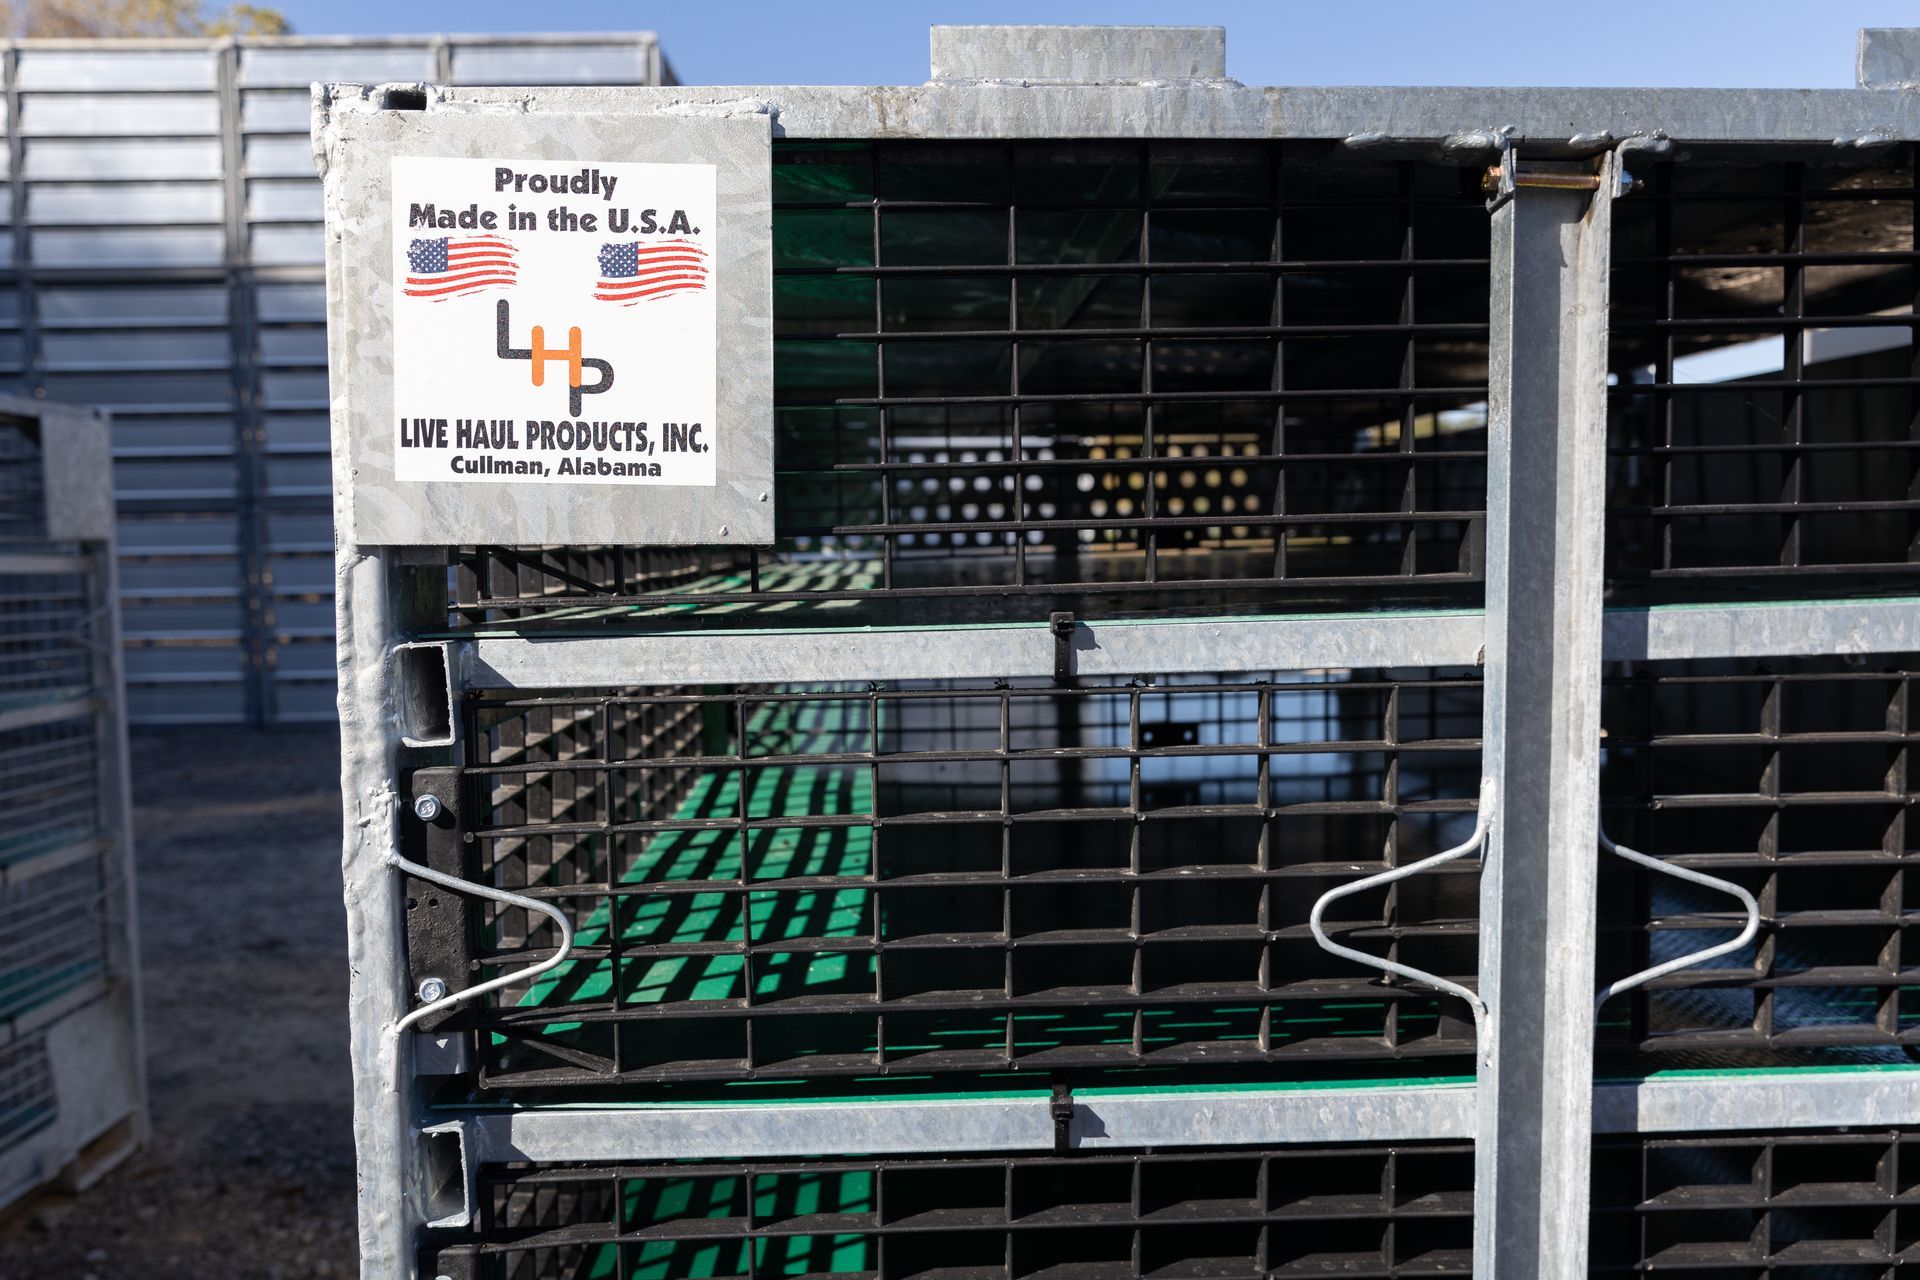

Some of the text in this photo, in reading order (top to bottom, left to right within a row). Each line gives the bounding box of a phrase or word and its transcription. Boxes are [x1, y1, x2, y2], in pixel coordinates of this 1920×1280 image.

[495, 167, 618, 201] Proudly
[408, 203, 701, 235] Made in the U.S.A.
[496, 298, 615, 418] LHP
[400, 418, 710, 456] LIVE HAUL PRODUCTS, INC.
[450, 455, 662, 478] Cullman, Alabama
